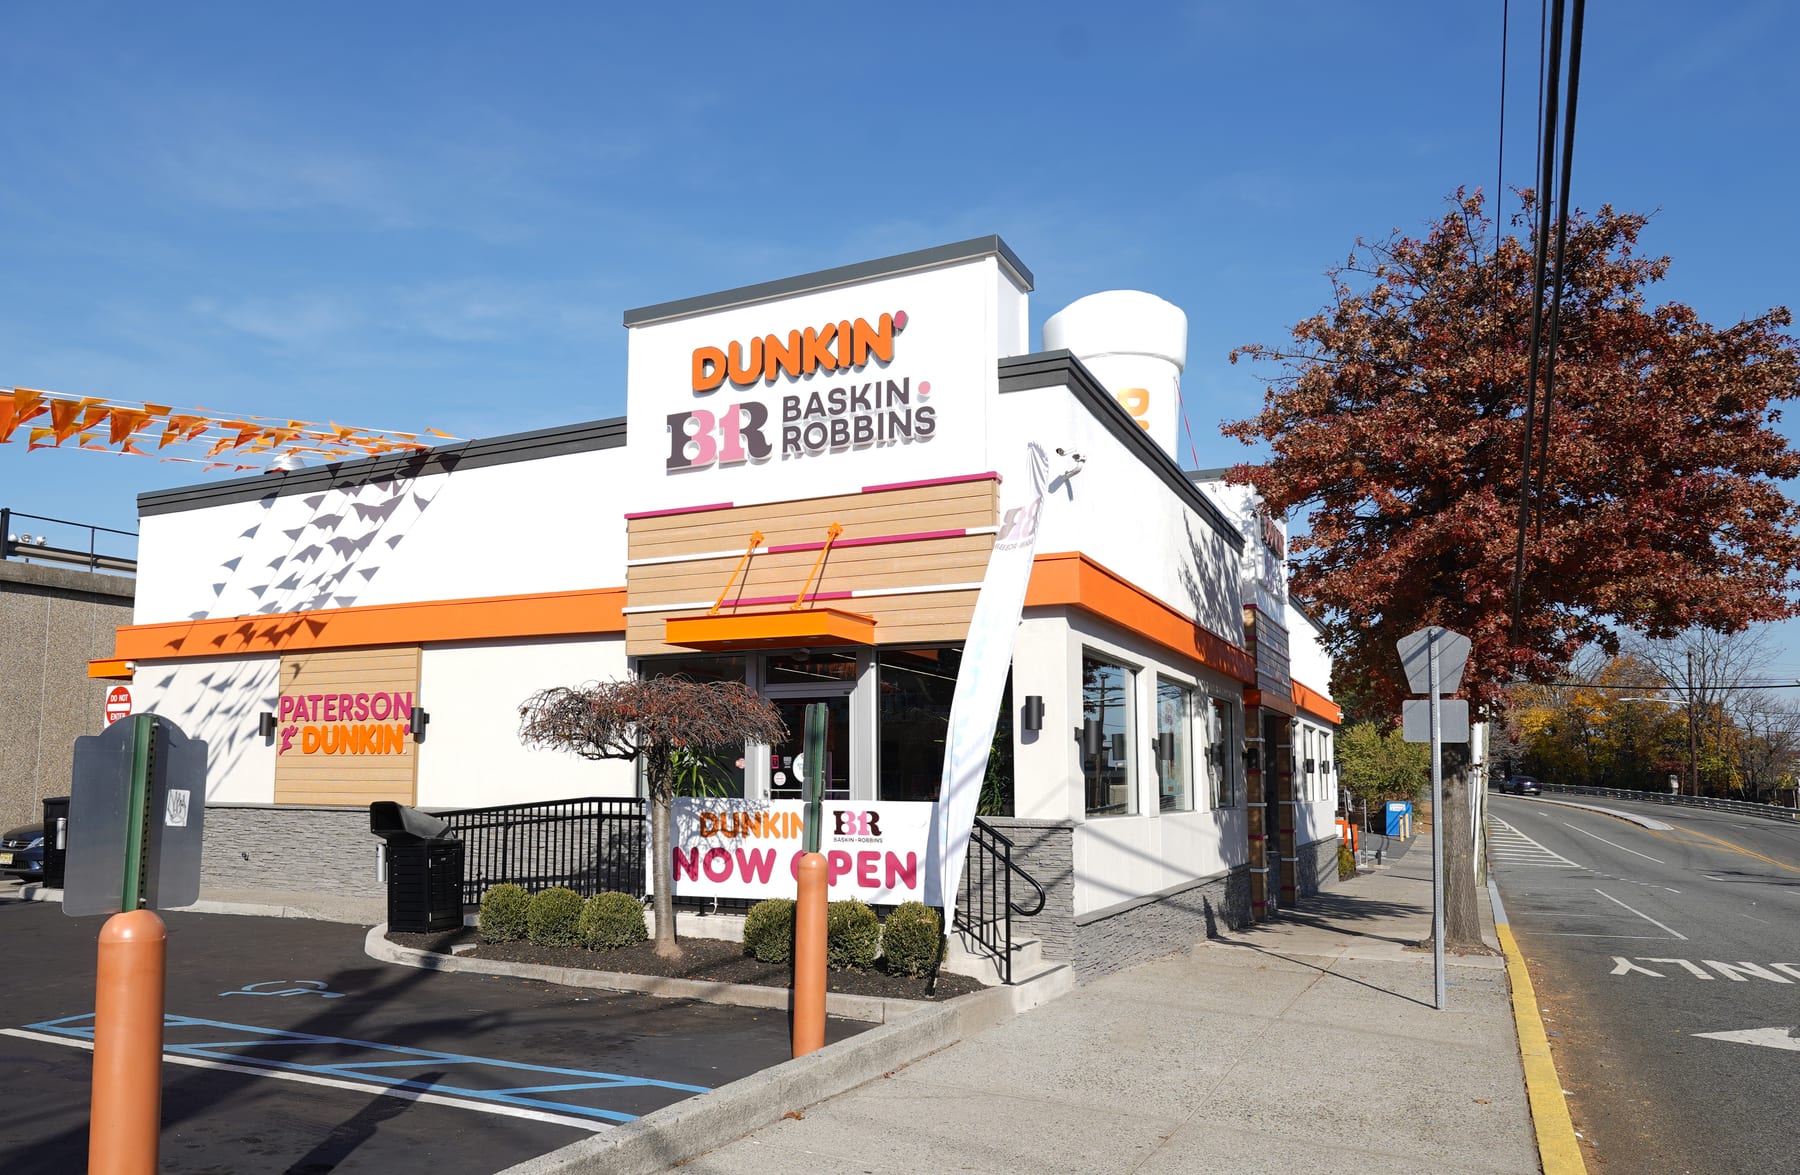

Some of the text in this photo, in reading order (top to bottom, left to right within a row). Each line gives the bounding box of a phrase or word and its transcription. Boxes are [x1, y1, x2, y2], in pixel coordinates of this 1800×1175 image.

[692, 310, 907, 391] DUNKIN'
[783, 377, 910, 422] BASKIN
[782, 406, 936, 453] ROBBINS
[110, 694, 128, 702] DO NOT
[279, 691, 412, 722] PATERSON
[302, 723, 410, 755] DUNKIN'
[672, 846, 777, 884] NOW
